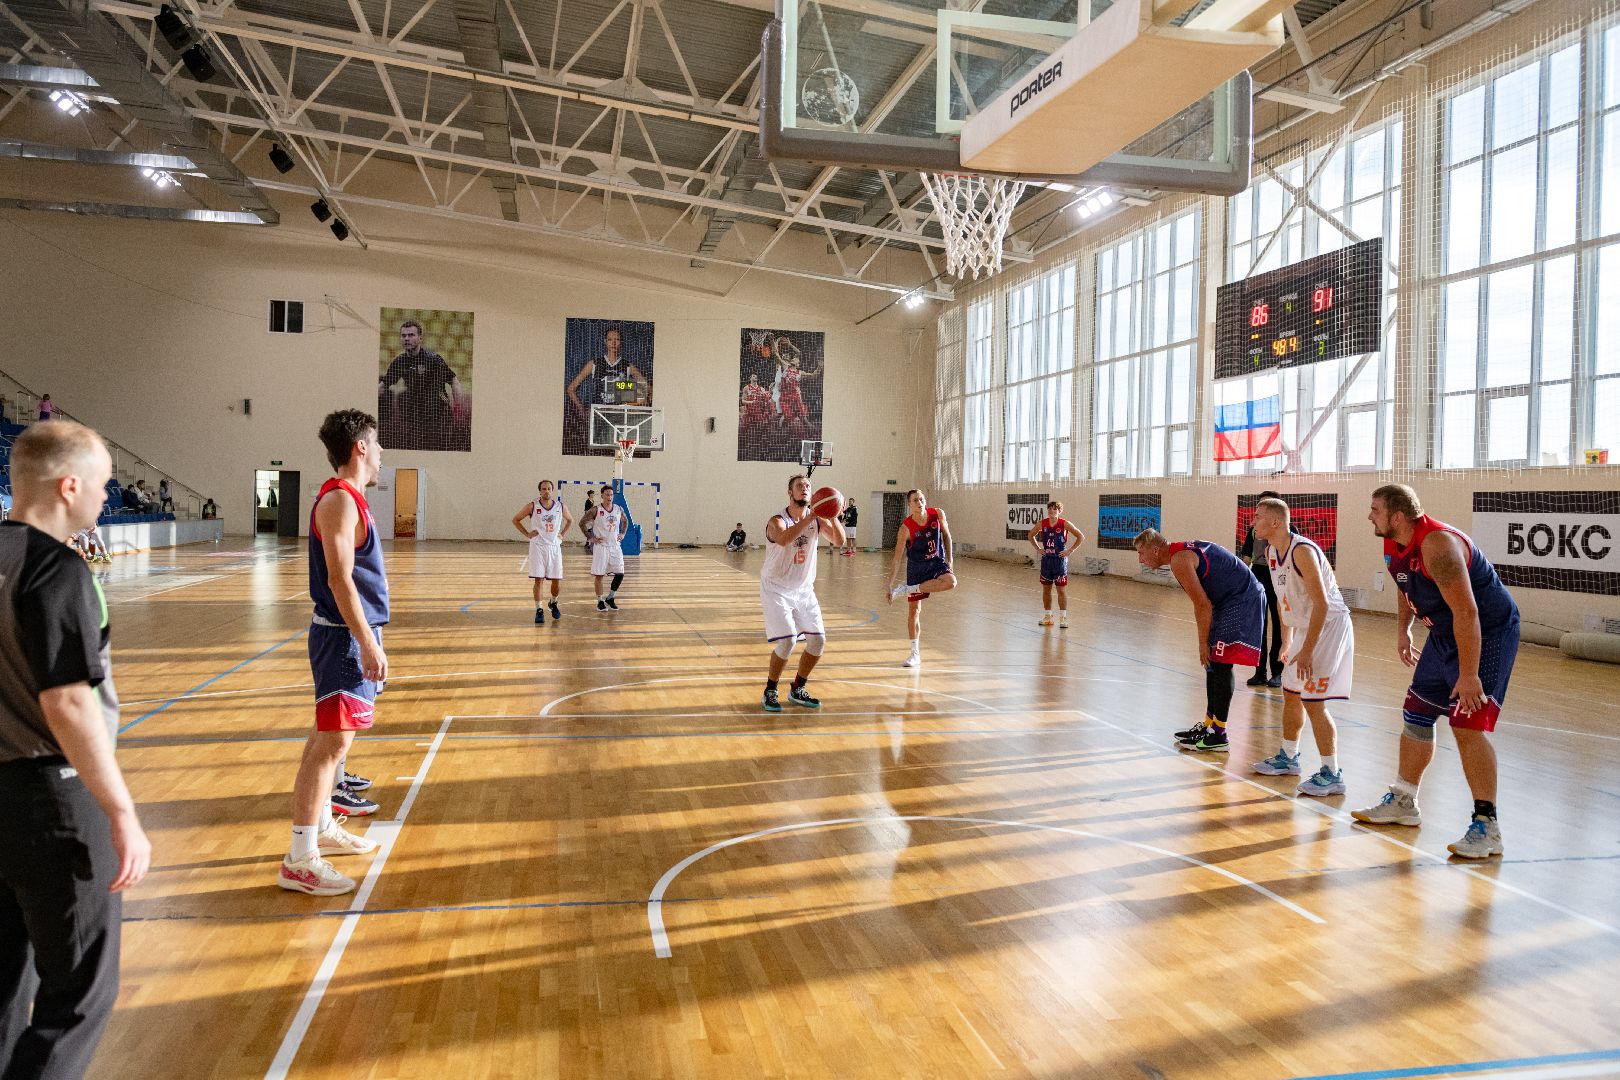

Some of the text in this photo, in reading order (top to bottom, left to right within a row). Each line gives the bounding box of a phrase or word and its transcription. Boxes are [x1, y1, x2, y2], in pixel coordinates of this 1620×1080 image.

[1286, 302, 1292, 312] 4
[1314, 287, 1333, 312] 91
[1251, 303, 1269, 327] 86
[1318, 341, 1324, 355] 3
[1254, 355, 1259, 365] 4
[1008, 507, 1044, 525] ФУТБОЛ
[1101, 511, 1156, 532] ВОЛЕЙБОЛ
[544, 523, 554, 533] 13
[927, 539, 936, 552] 31
[1507, 522, 1612, 560] БОКС
[793, 549, 806, 565] 15
[1215, 640, 1225, 657] 9
[1303, 677, 1330, 695] 45
